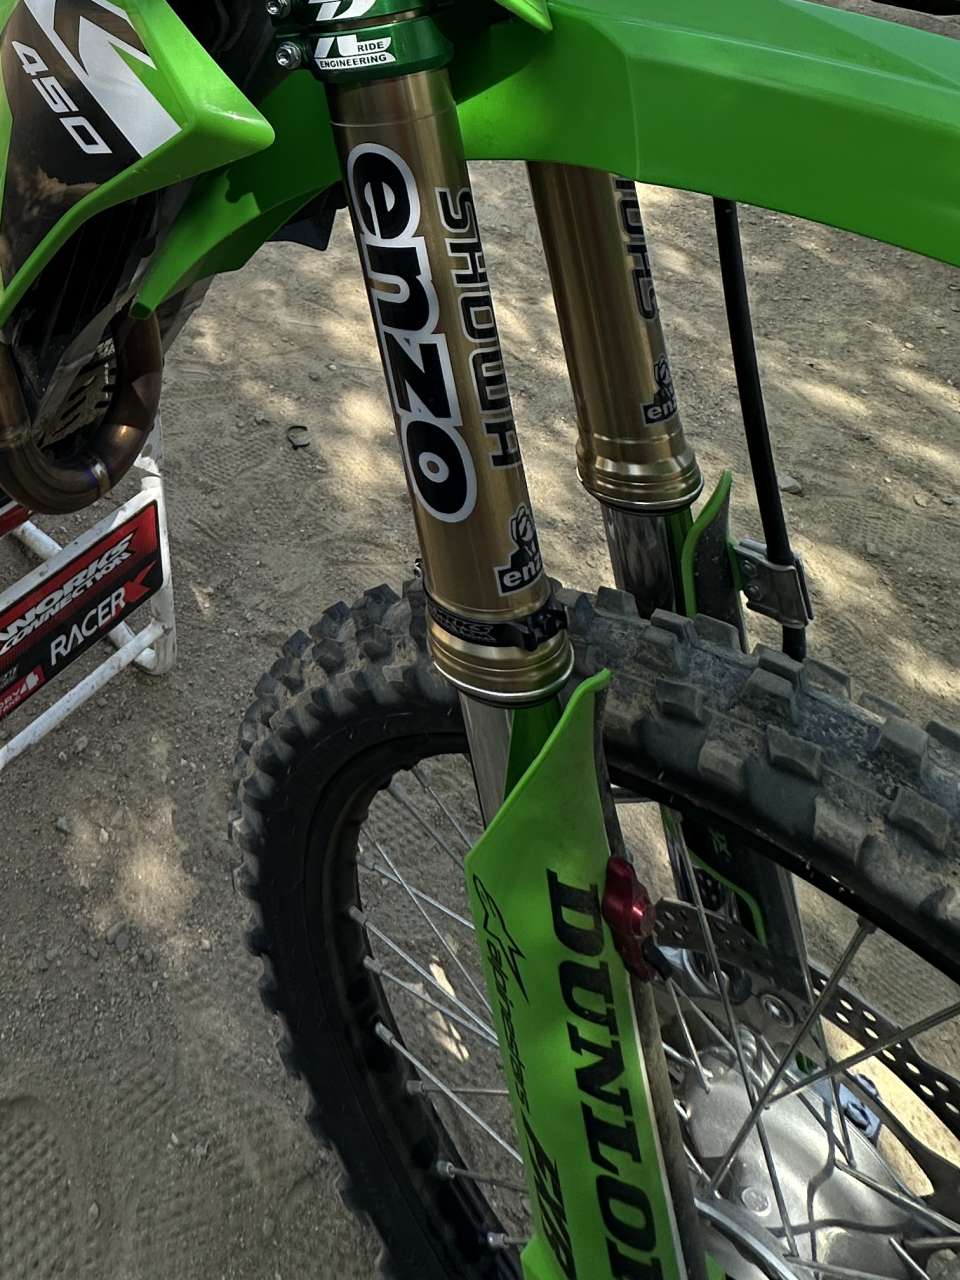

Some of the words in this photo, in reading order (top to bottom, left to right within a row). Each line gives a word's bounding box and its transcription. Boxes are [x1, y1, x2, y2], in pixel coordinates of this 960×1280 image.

[320, 54, 387, 69] ENGINEERING
[357, 41, 385, 53] RIDE
[11, 40, 114, 155] 450
[347, 143, 478, 522] enzo
[436, 187, 523, 469] SHOWA
[50, 587, 126, 666] RACER
